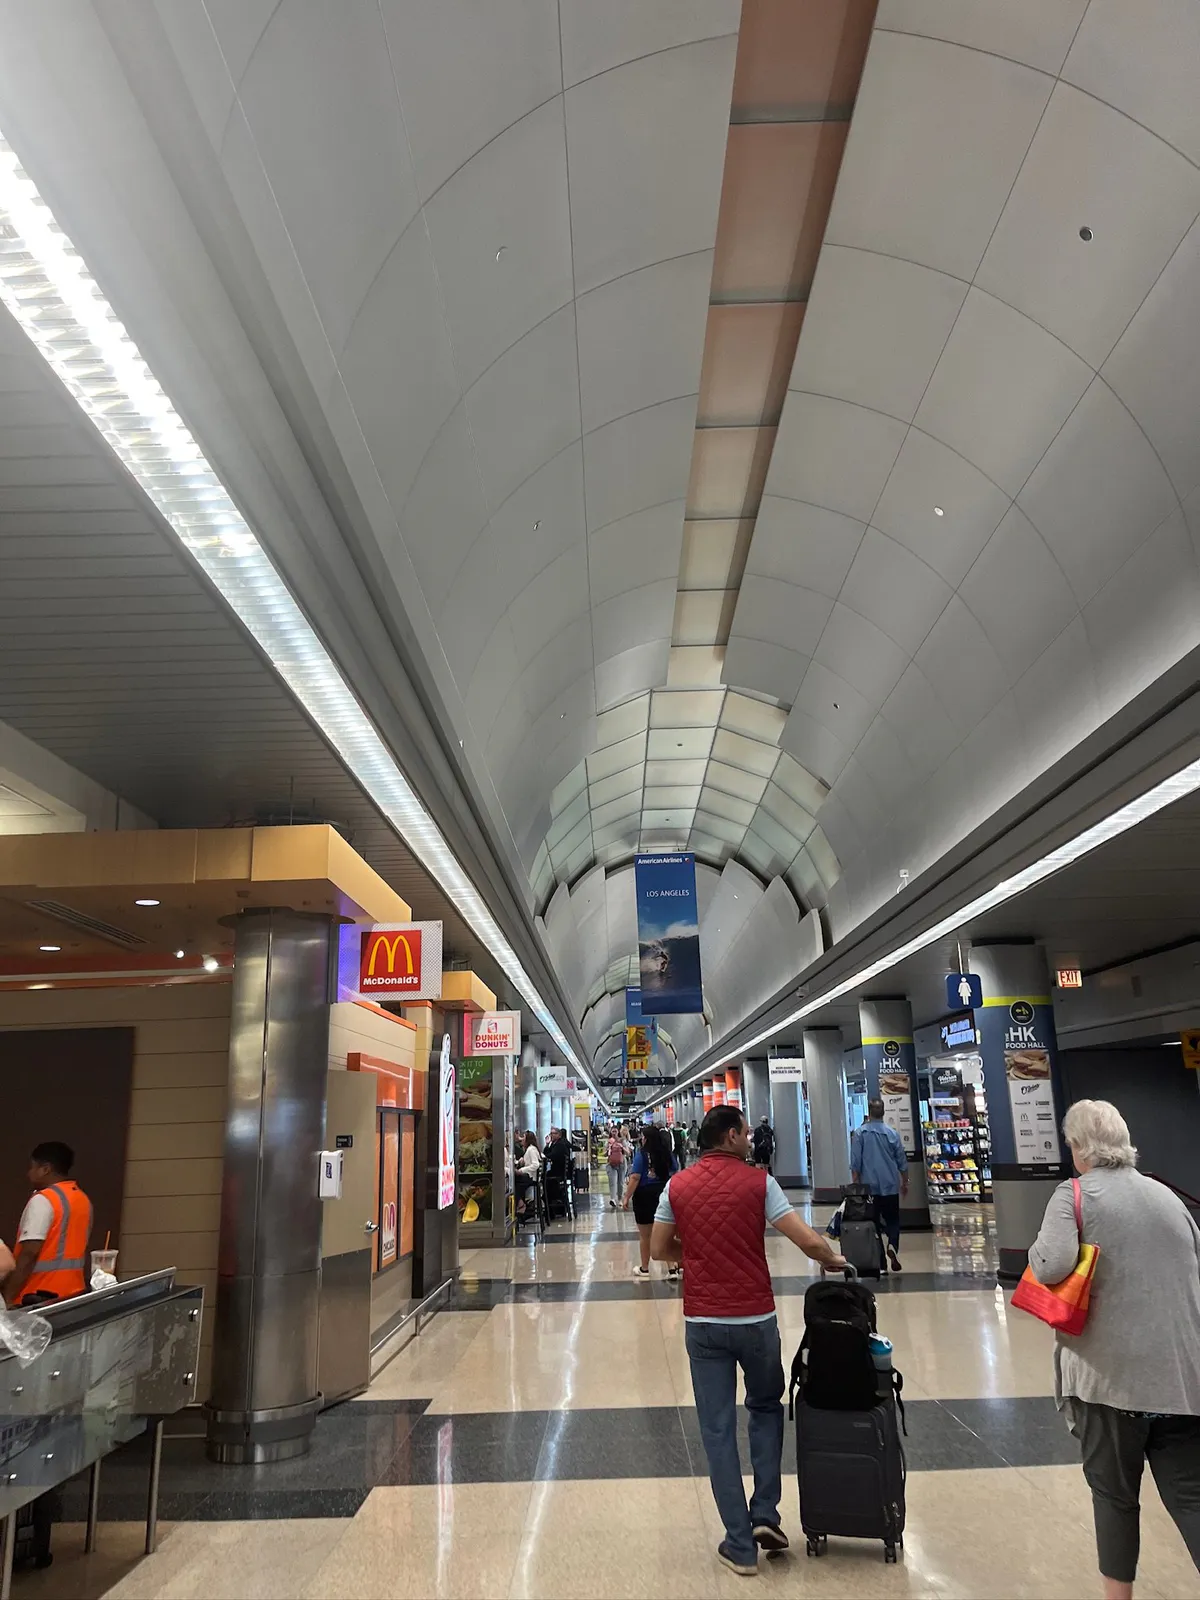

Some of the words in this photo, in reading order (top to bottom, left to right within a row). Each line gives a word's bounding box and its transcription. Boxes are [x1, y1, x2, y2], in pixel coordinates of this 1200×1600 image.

[660, 889, 690, 897] ANGELES
[363, 976, 419, 986] McDonald's
[1060, 971, 1078, 983] EXIT
[475, 1033, 510, 1042] DUNKIN'
[1009, 1026, 1037, 1042] HK
[1027, 1041, 1046, 1049] HALL
[882, 1057, 902, 1069] HK
